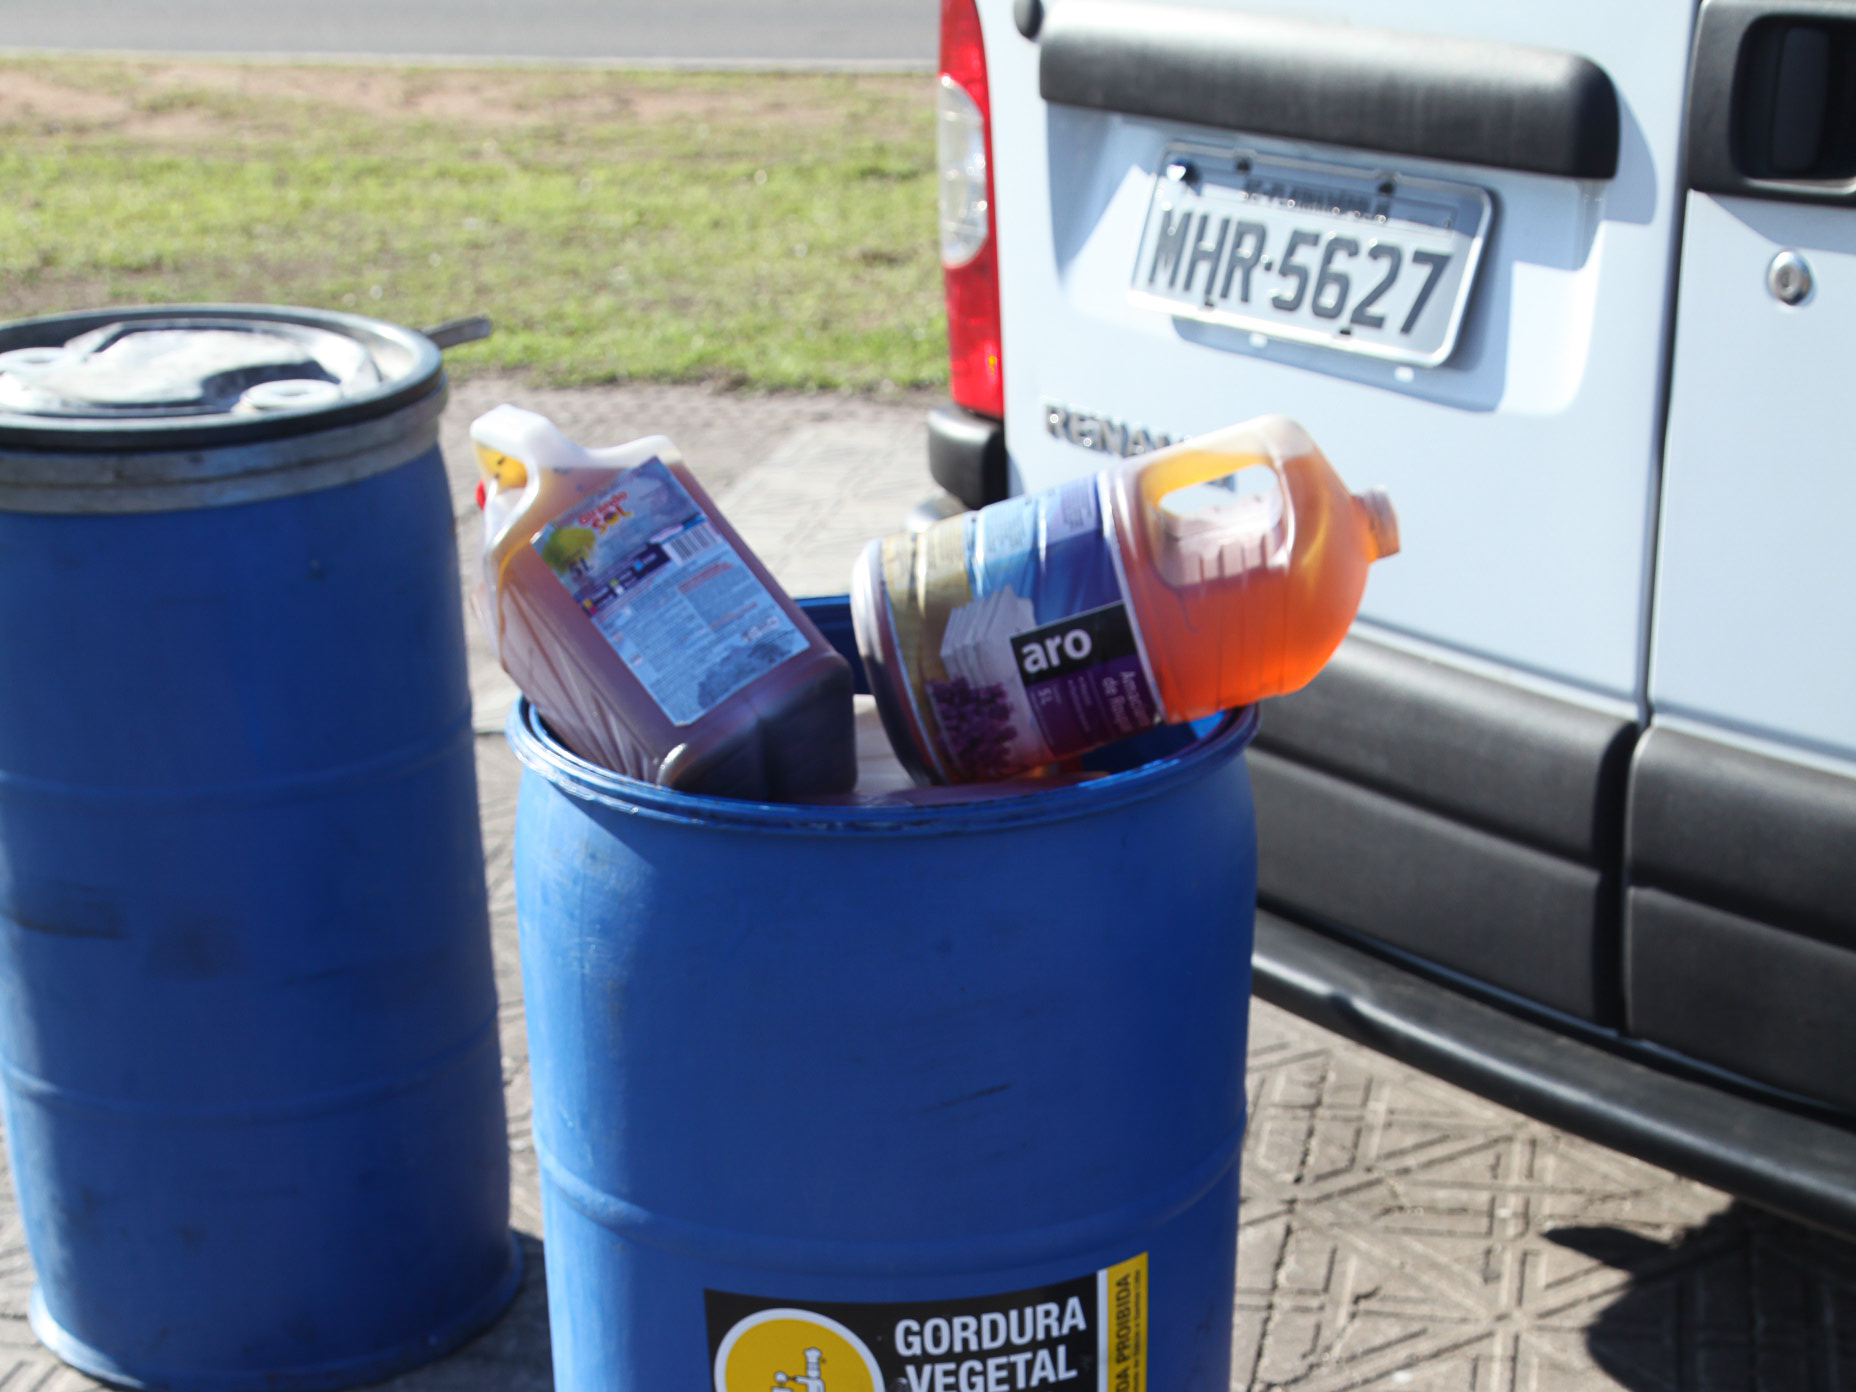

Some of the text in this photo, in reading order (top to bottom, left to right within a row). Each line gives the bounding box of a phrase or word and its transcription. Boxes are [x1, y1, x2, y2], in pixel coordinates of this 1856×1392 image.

[1020, 628, 1093, 675] aro
[894, 1295, 1087, 1358] GORDURA
[1114, 1272, 1132, 1365] PROIBIDA
